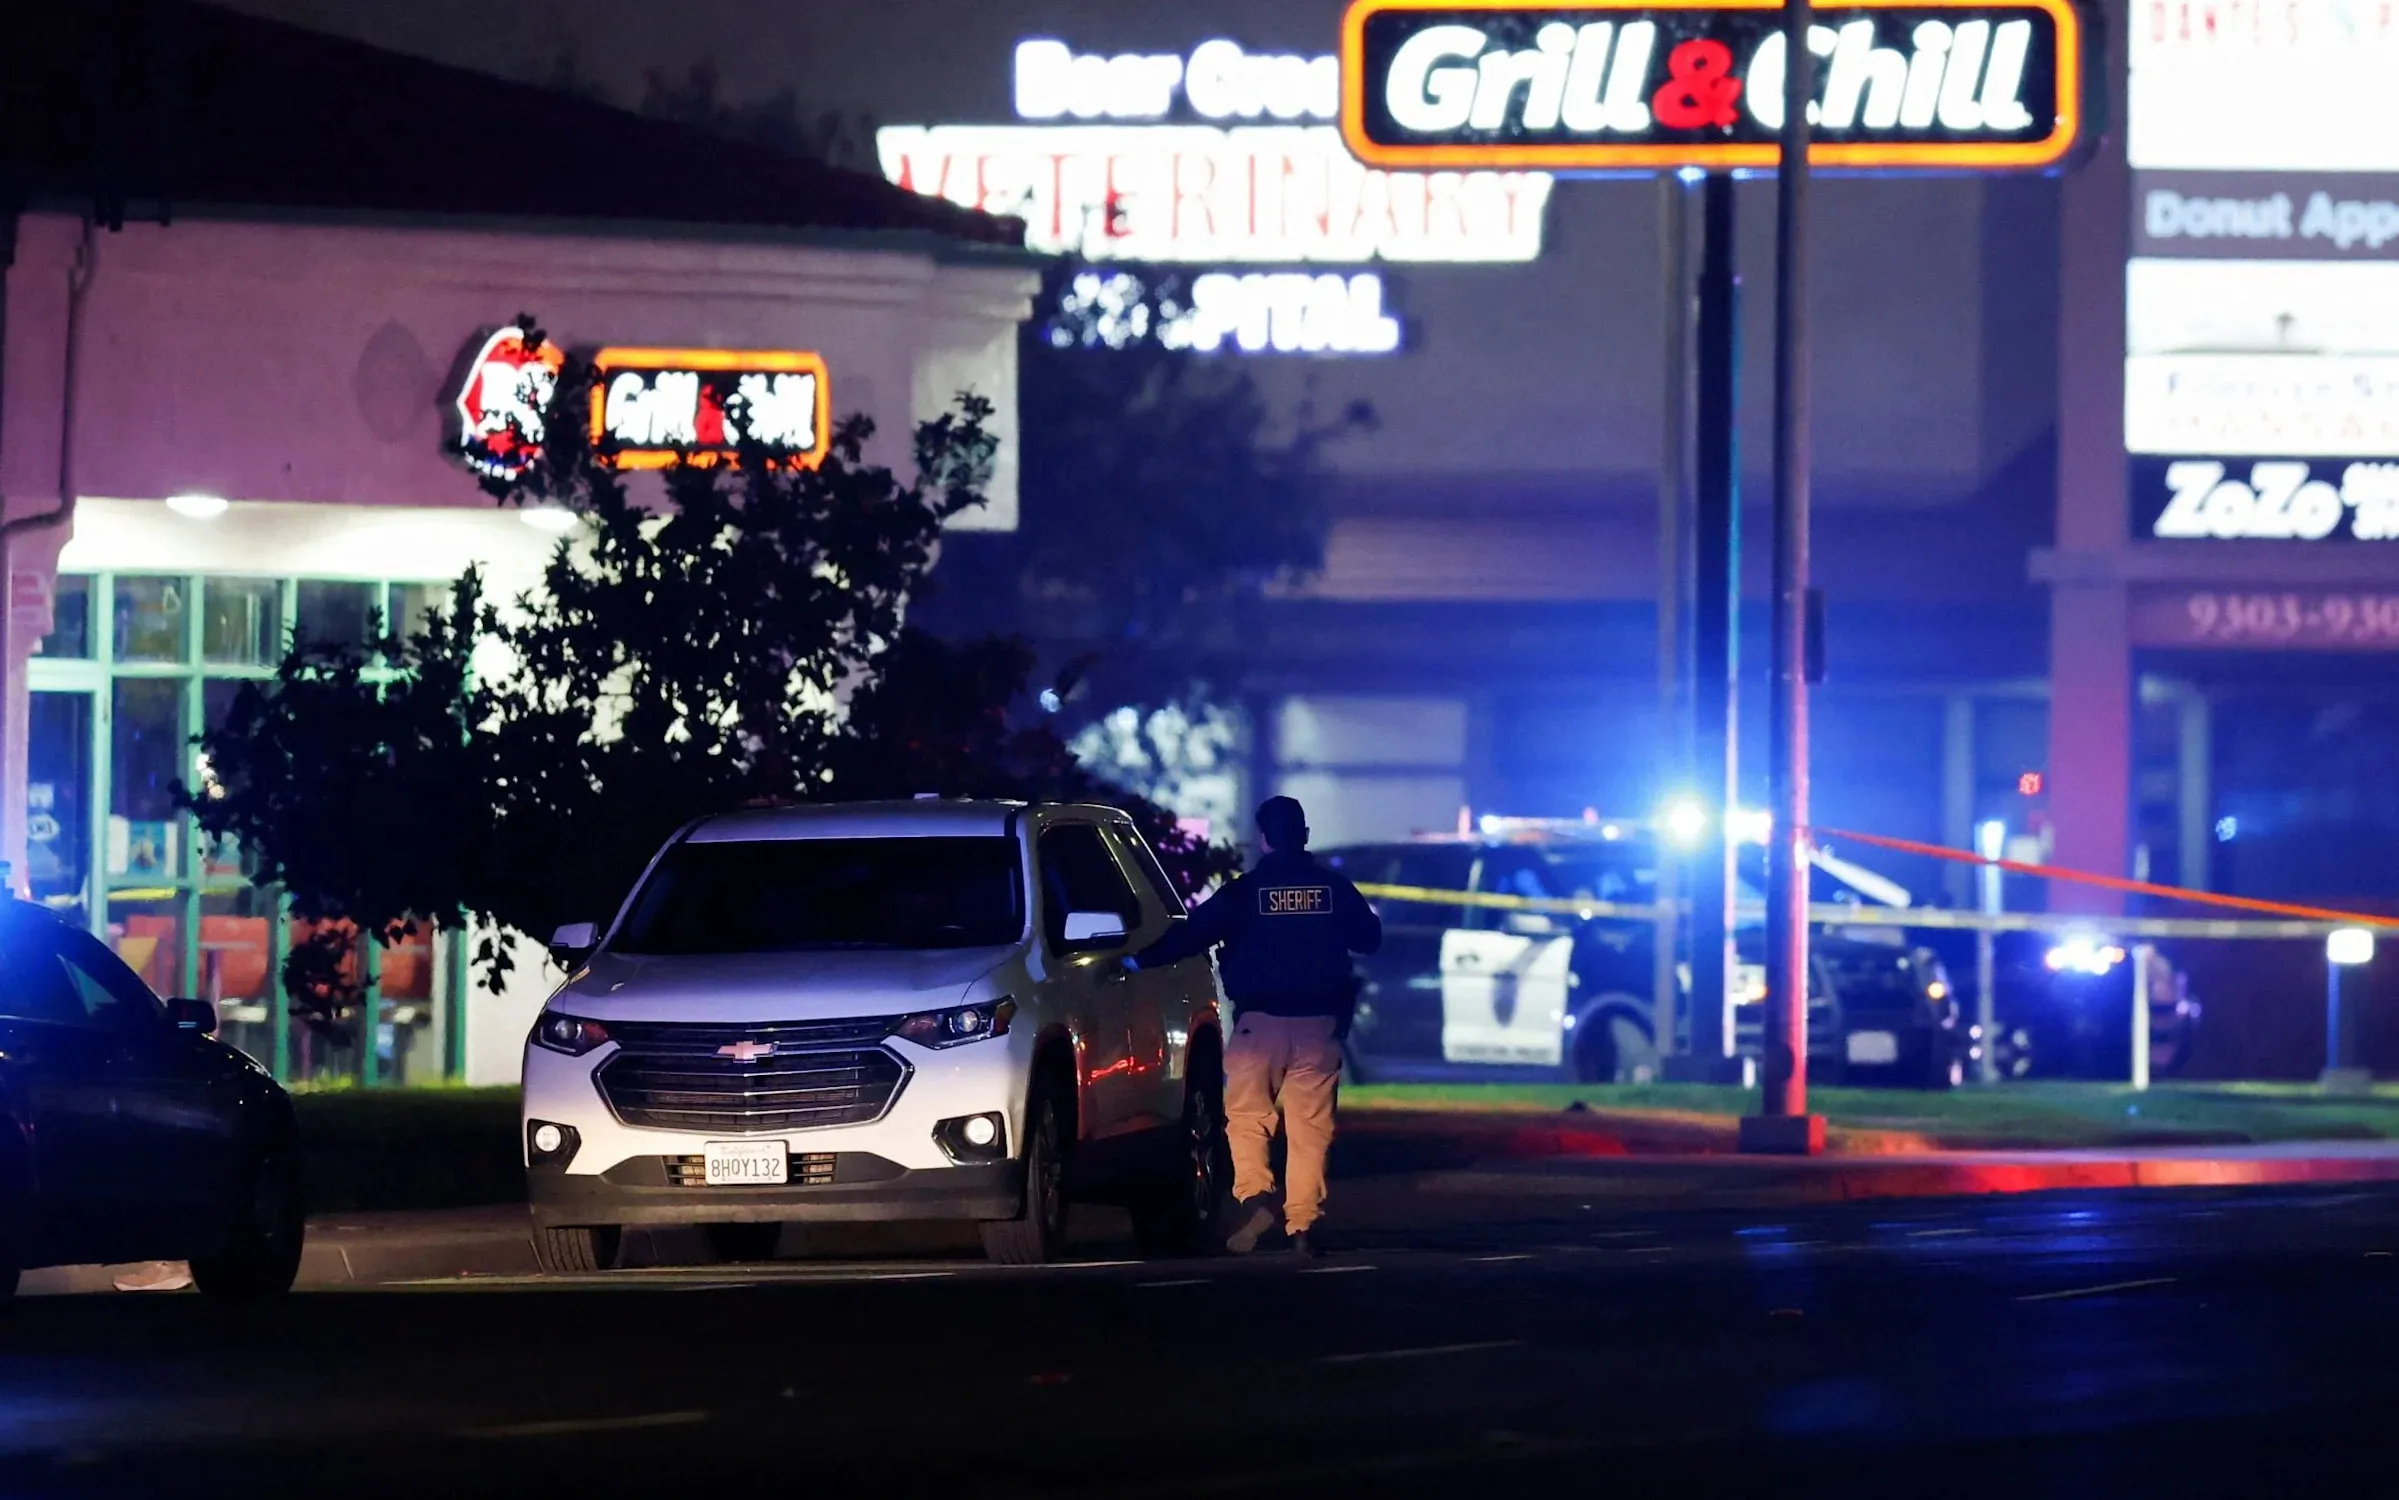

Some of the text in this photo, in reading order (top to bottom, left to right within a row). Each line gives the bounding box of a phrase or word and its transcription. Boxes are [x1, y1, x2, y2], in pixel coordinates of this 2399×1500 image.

[1386, 21, 1652, 131] Grill
[1651, 38, 1742, 128] &
[876, 125, 1553, 261] VETERINARY
[2146, 190, 2294, 238] Donut
[1269, 889, 1323, 912] SHERIFF
